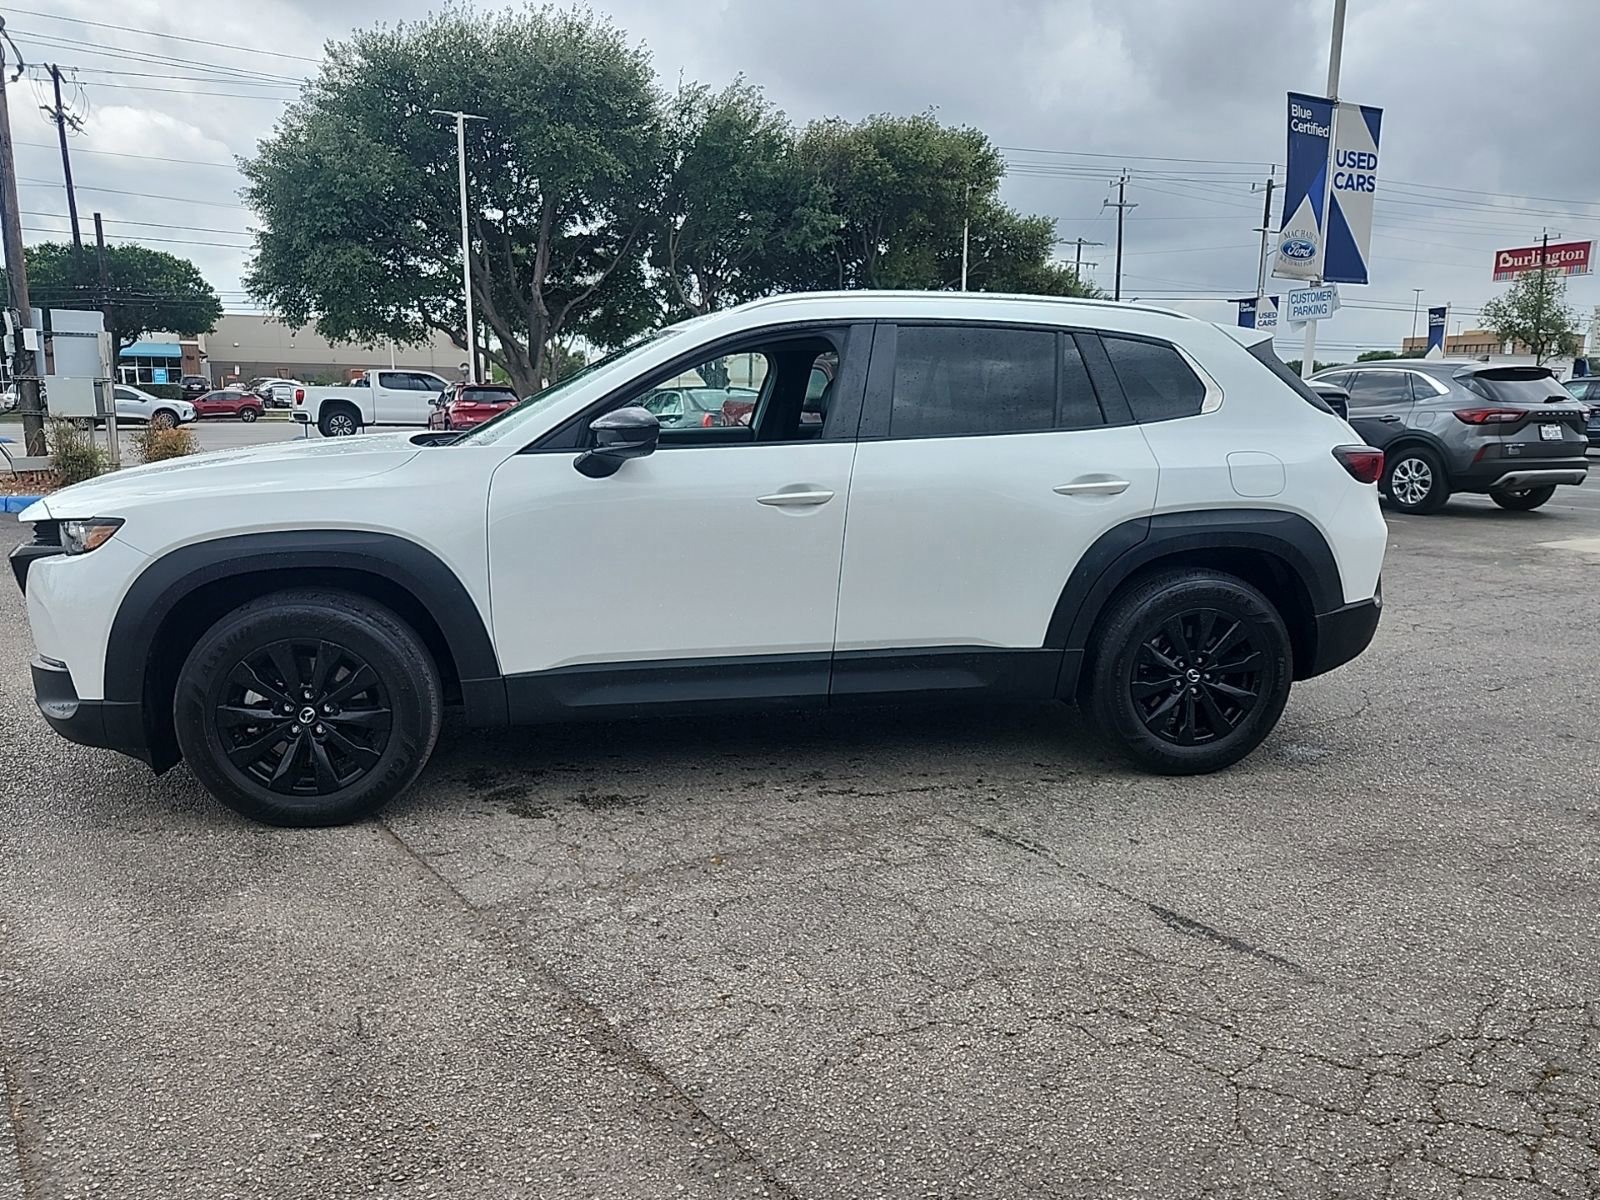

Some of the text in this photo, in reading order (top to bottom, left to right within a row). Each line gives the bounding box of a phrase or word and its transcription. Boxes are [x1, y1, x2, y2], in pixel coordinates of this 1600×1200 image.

[1291, 104, 1312, 119] Blue
[1291, 119, 1329, 138] Certified
[1336, 149, 1378, 170] USED
[1334, 172, 1376, 192] CARS
[1288, 240, 1312, 257] Ford
[1499, 249, 1585, 267] Burlington
[1291, 290, 1333, 304] CUSTOMER
[1258, 311, 1278, 319] USED
[1293, 304, 1328, 317] PARKING
[1257, 319, 1278, 327] CARS
